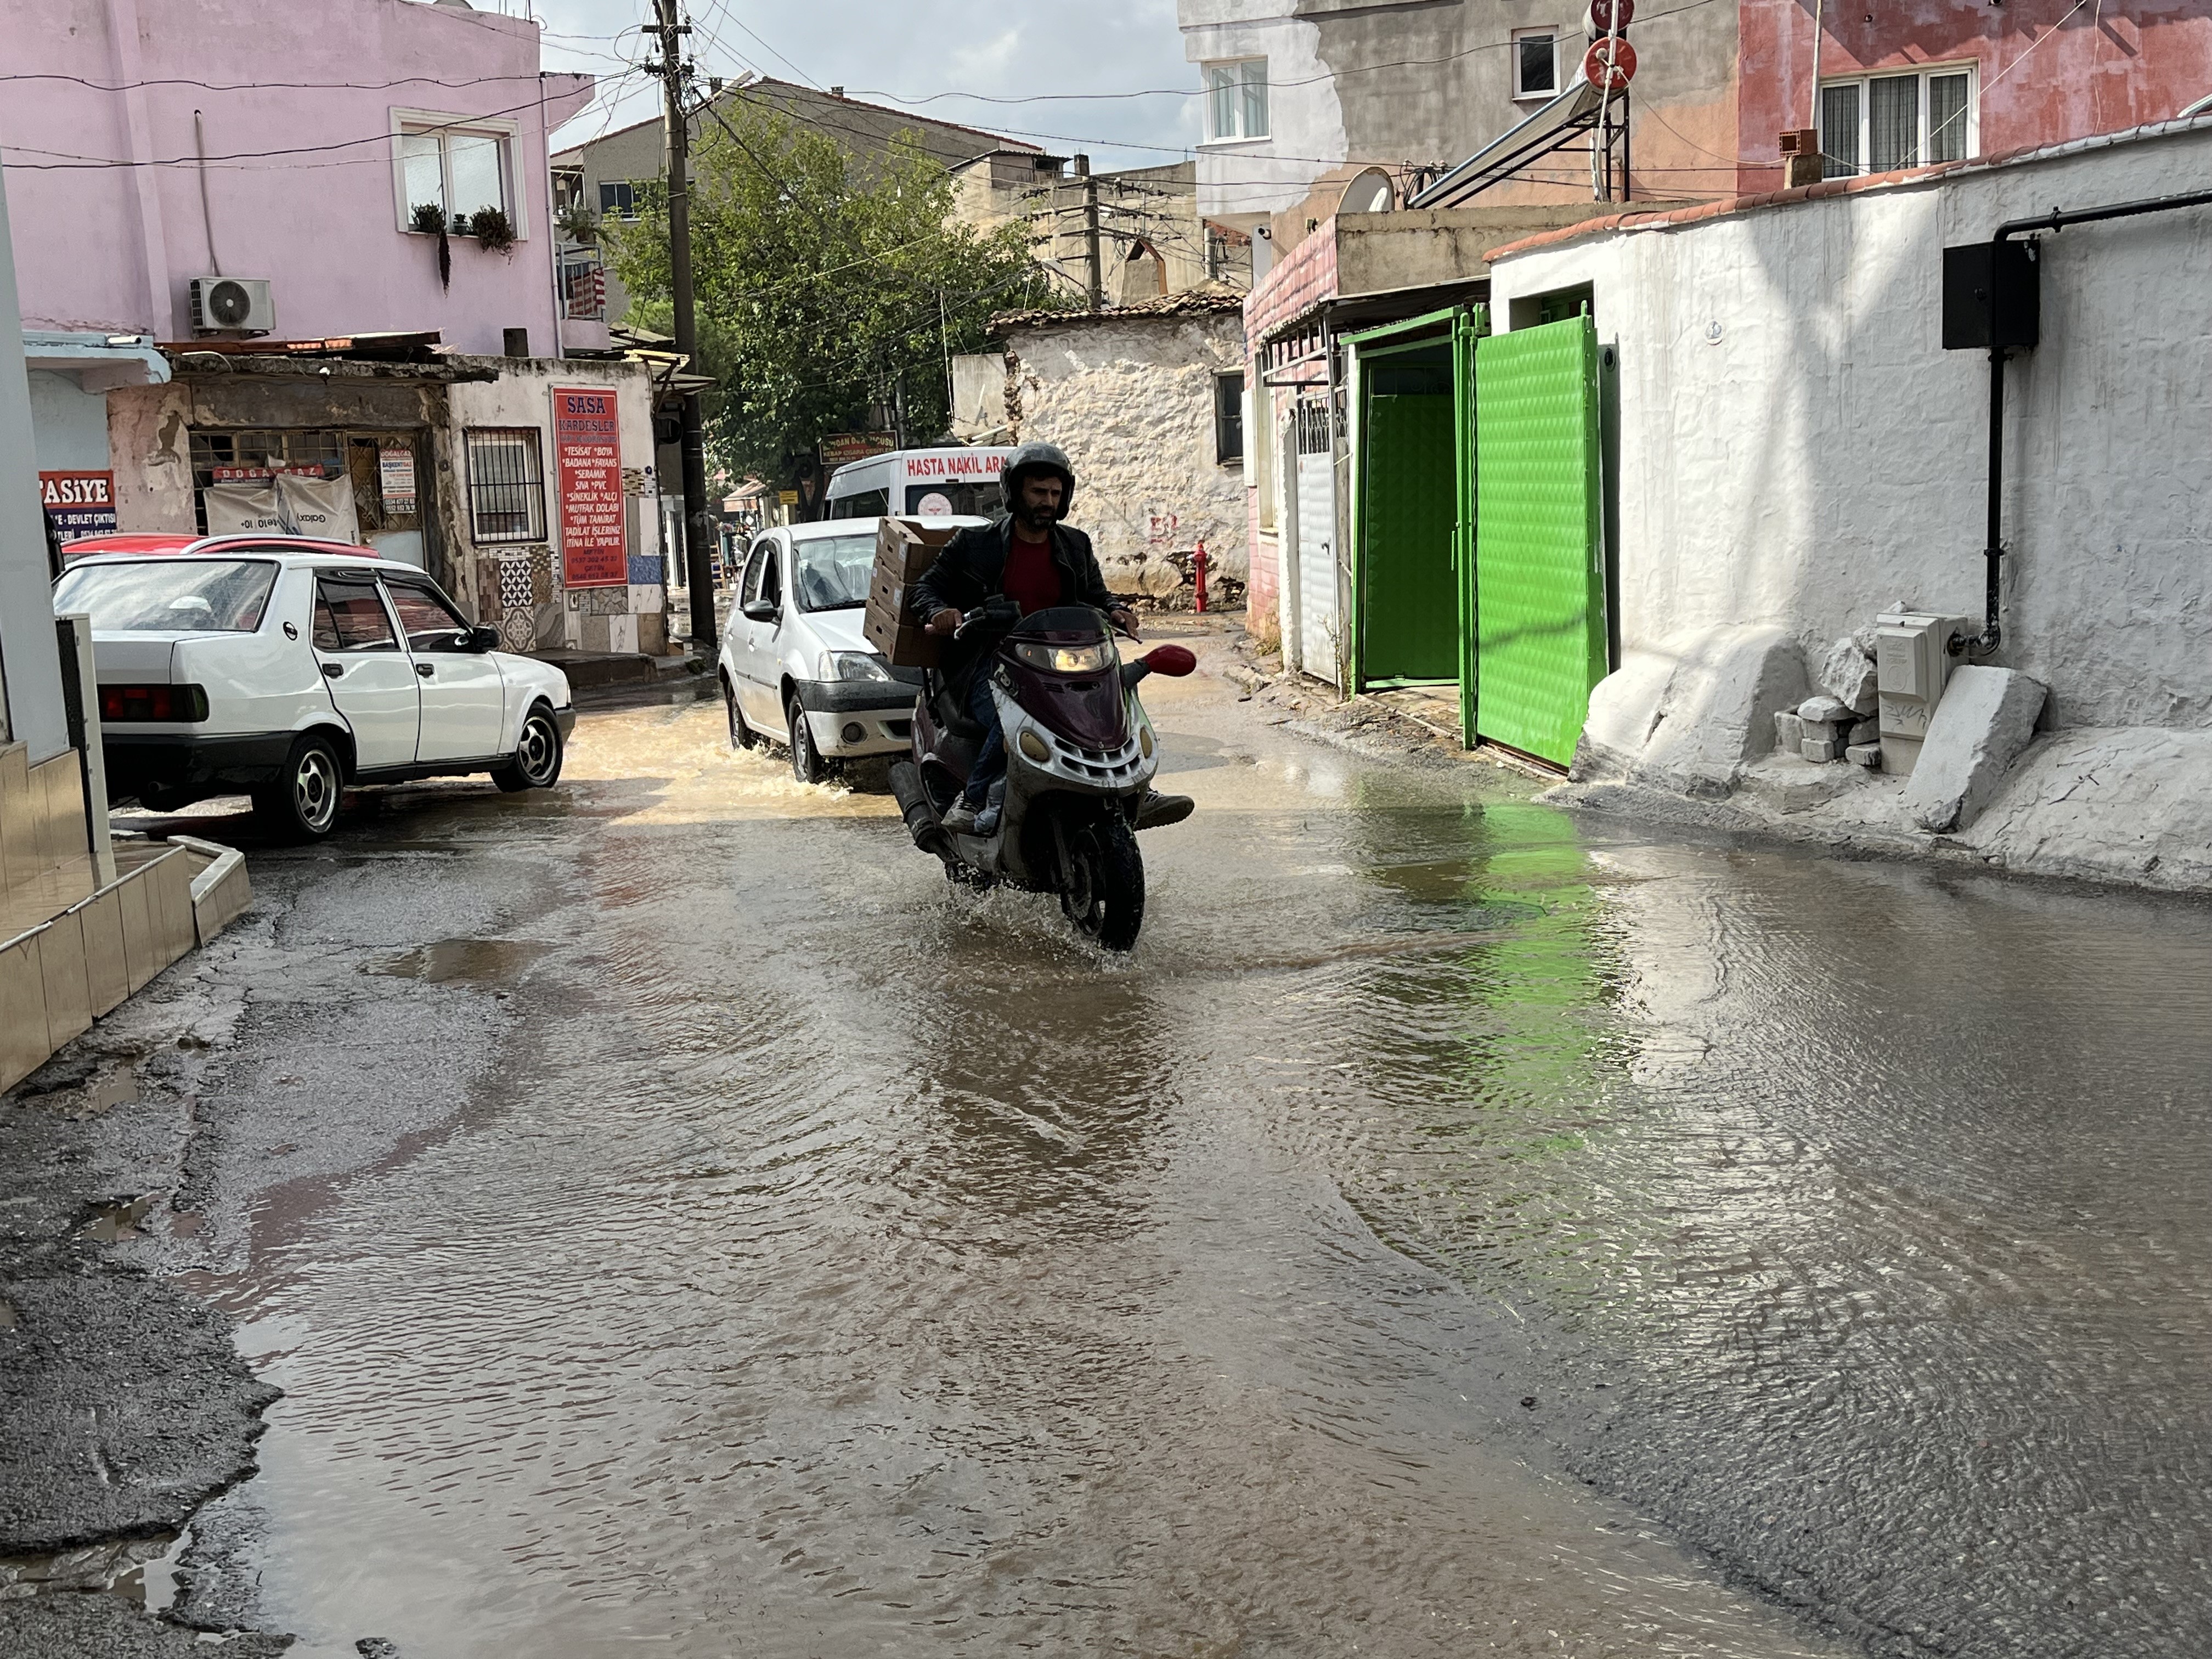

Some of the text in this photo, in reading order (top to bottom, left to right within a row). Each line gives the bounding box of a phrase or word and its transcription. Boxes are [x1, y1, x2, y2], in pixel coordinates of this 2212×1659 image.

[567, 396, 606, 414] SASA
[567, 445, 613, 456] TESİSAT BOYA
[565, 458, 617, 467] BADANA FAYANS
[907, 458, 945, 477] HASTA
[947, 453, 982, 475] NAKİL
[577, 468, 607, 479] SERAMİK
[594, 481, 607, 490] PVC
[569, 490, 618, 503] SİNEKLİK ALÇI
[568, 503, 619, 513] MUTFAK DOLABI
[67, 514, 92, 524] DEVLET
[296, 512, 326, 523] Galaxy
[573, 514, 617, 524] TÜM TAMİRAT
[565, 524, 590, 536] TADİLAT
[566, 536, 583, 548] İTİNA
[584, 536, 594, 547] İLE
